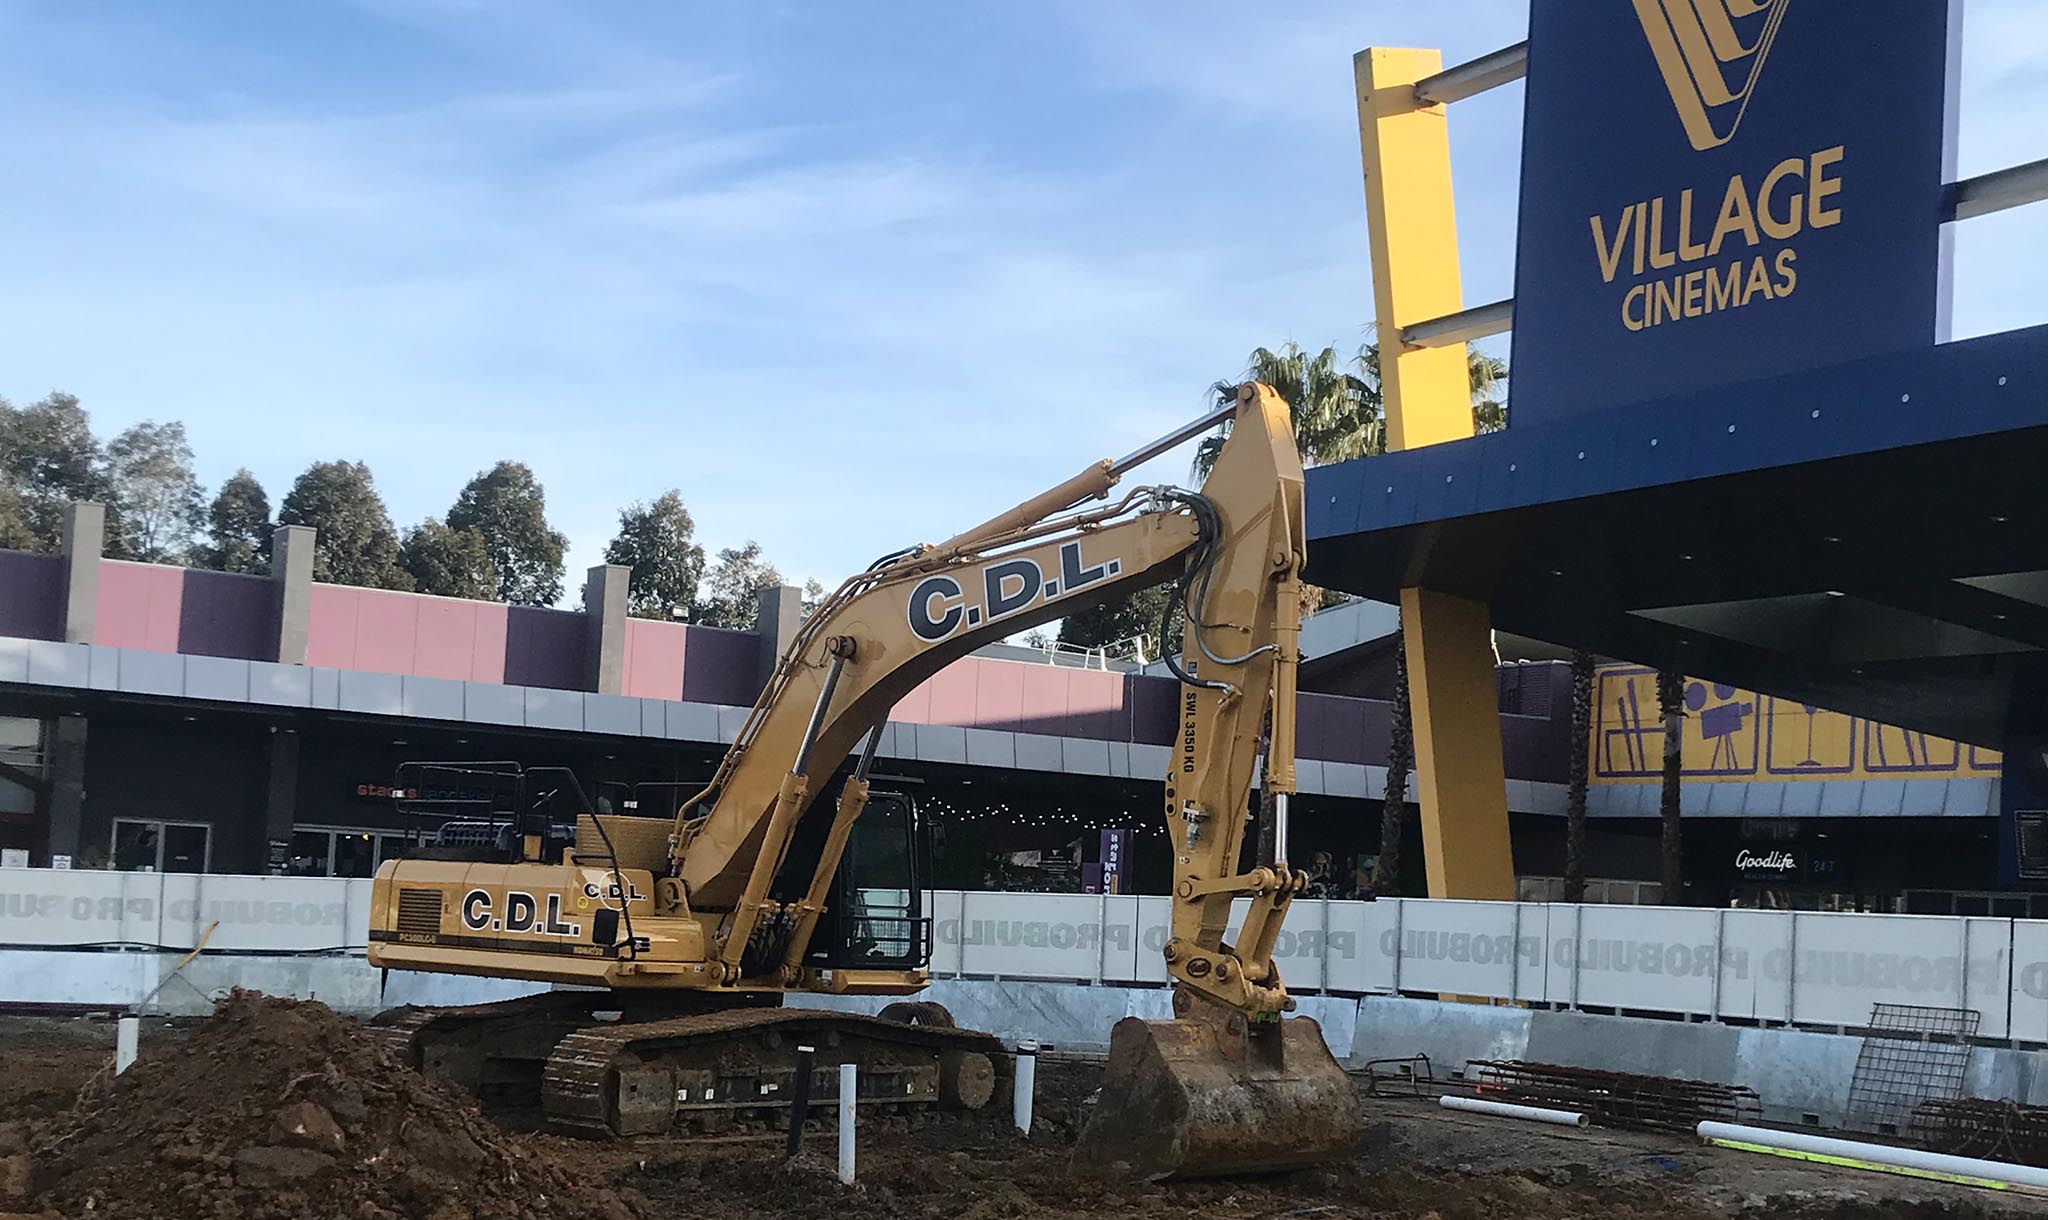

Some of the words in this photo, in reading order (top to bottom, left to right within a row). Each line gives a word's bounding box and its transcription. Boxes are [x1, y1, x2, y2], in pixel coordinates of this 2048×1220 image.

[1589, 145, 1844, 283] VILLAGE
[1621, 248, 1797, 331] CINEMAS
[907, 539, 1122, 643] C.D.L.
[1186, 692, 1197, 718] SWL
[1185, 722, 1196, 752] 3350
[1184, 756, 1195, 773] KG
[584, 882, 647, 900] C.D.L.
[462, 888, 581, 937] C.D.L.
